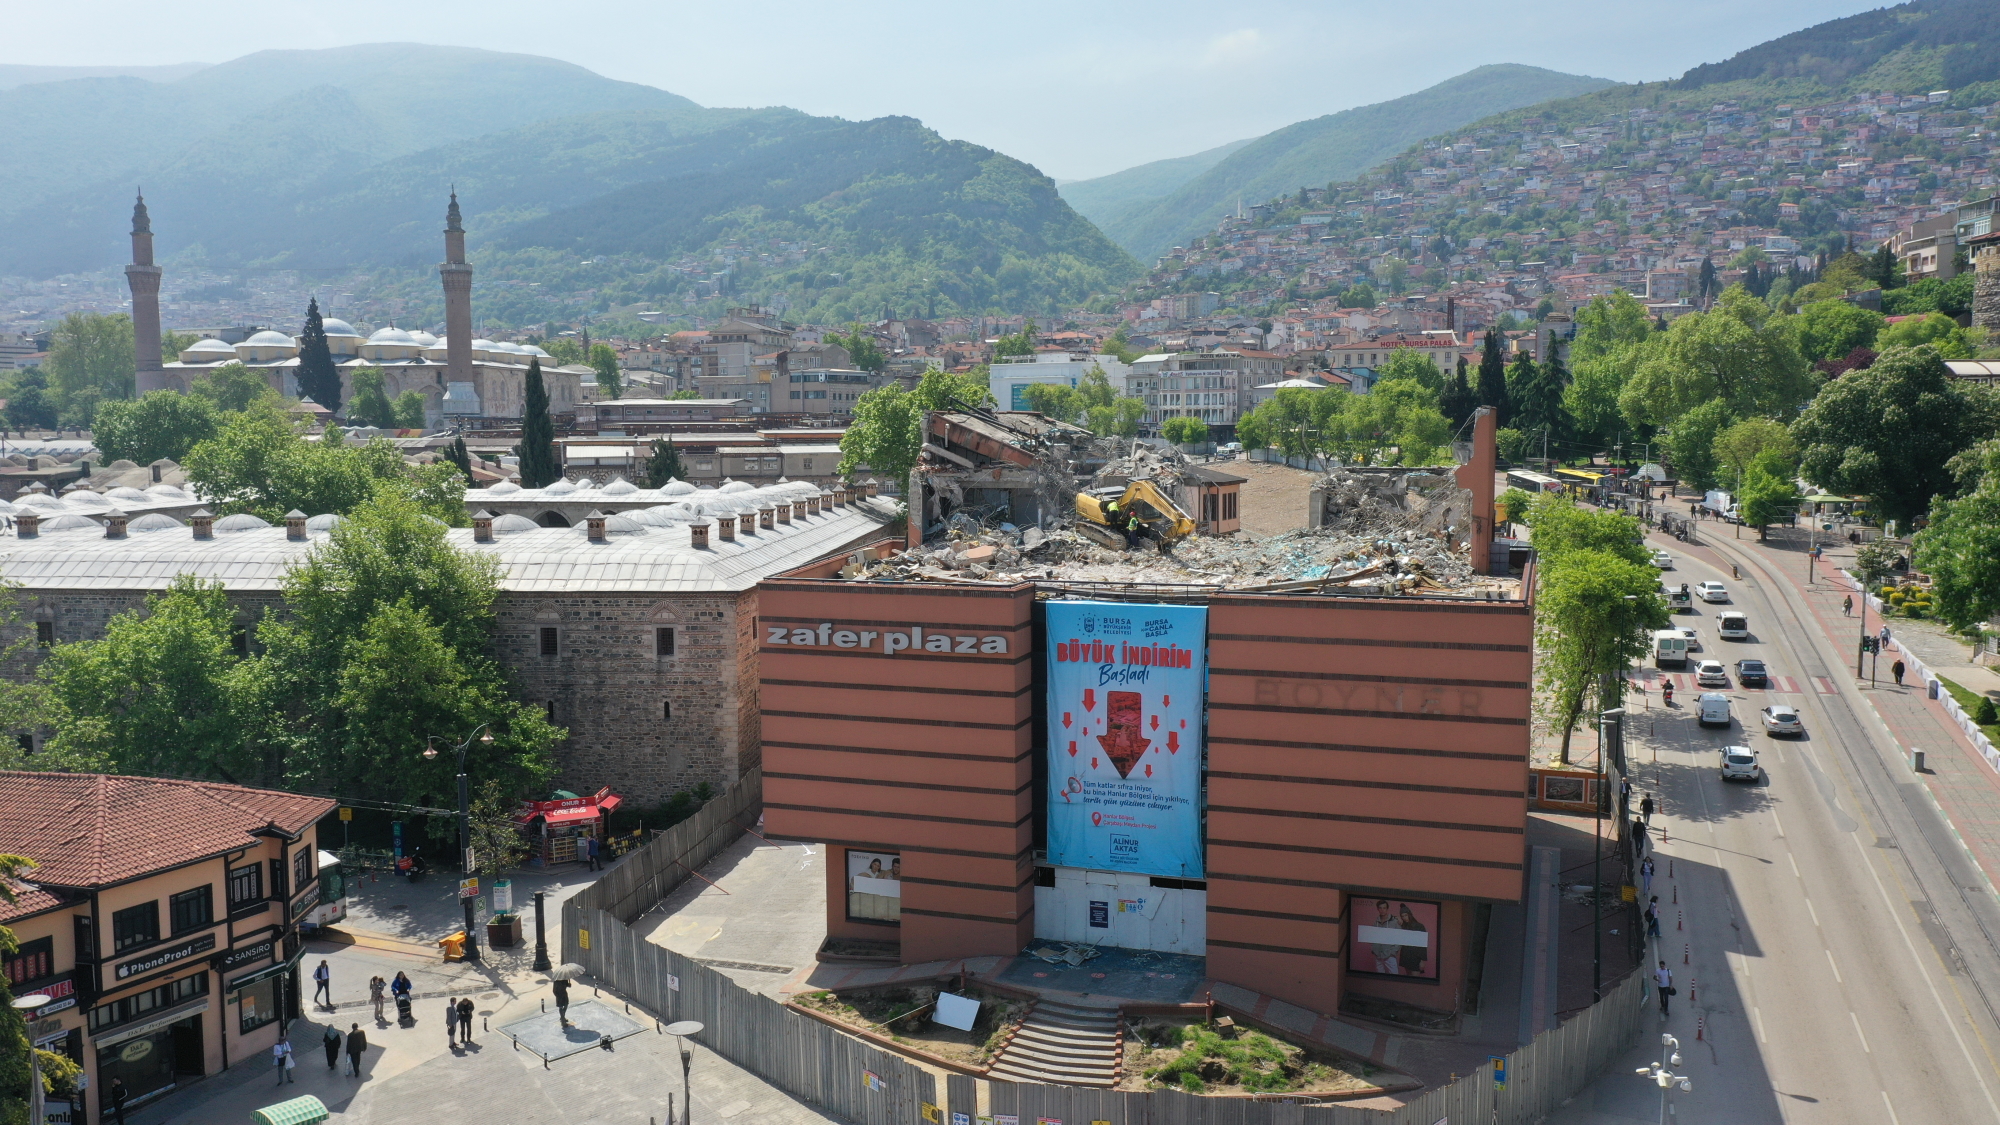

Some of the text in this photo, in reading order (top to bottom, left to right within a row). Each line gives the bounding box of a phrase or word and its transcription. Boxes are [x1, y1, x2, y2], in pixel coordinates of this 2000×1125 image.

[1145, 619, 1168, 627] BURSA
[1150, 624, 1173, 632] CANLA
[766, 623, 1008, 654] zafer plaza
[1057, 638, 1192, 669] BÜYÜK İNDİRİM
[1099, 664, 1150, 686] Başladı
[1134, 784, 1152, 793] iniyor,
[1128, 792, 1152, 800] Bölgesi
[1152, 794, 1164, 802] için
[1113, 838, 1138, 846] ALİNUR
[1114, 845, 1138, 854] AKTAŞ
[131, 946, 192, 974] PhoneProof
[130, 1042, 144, 1052] D&P
